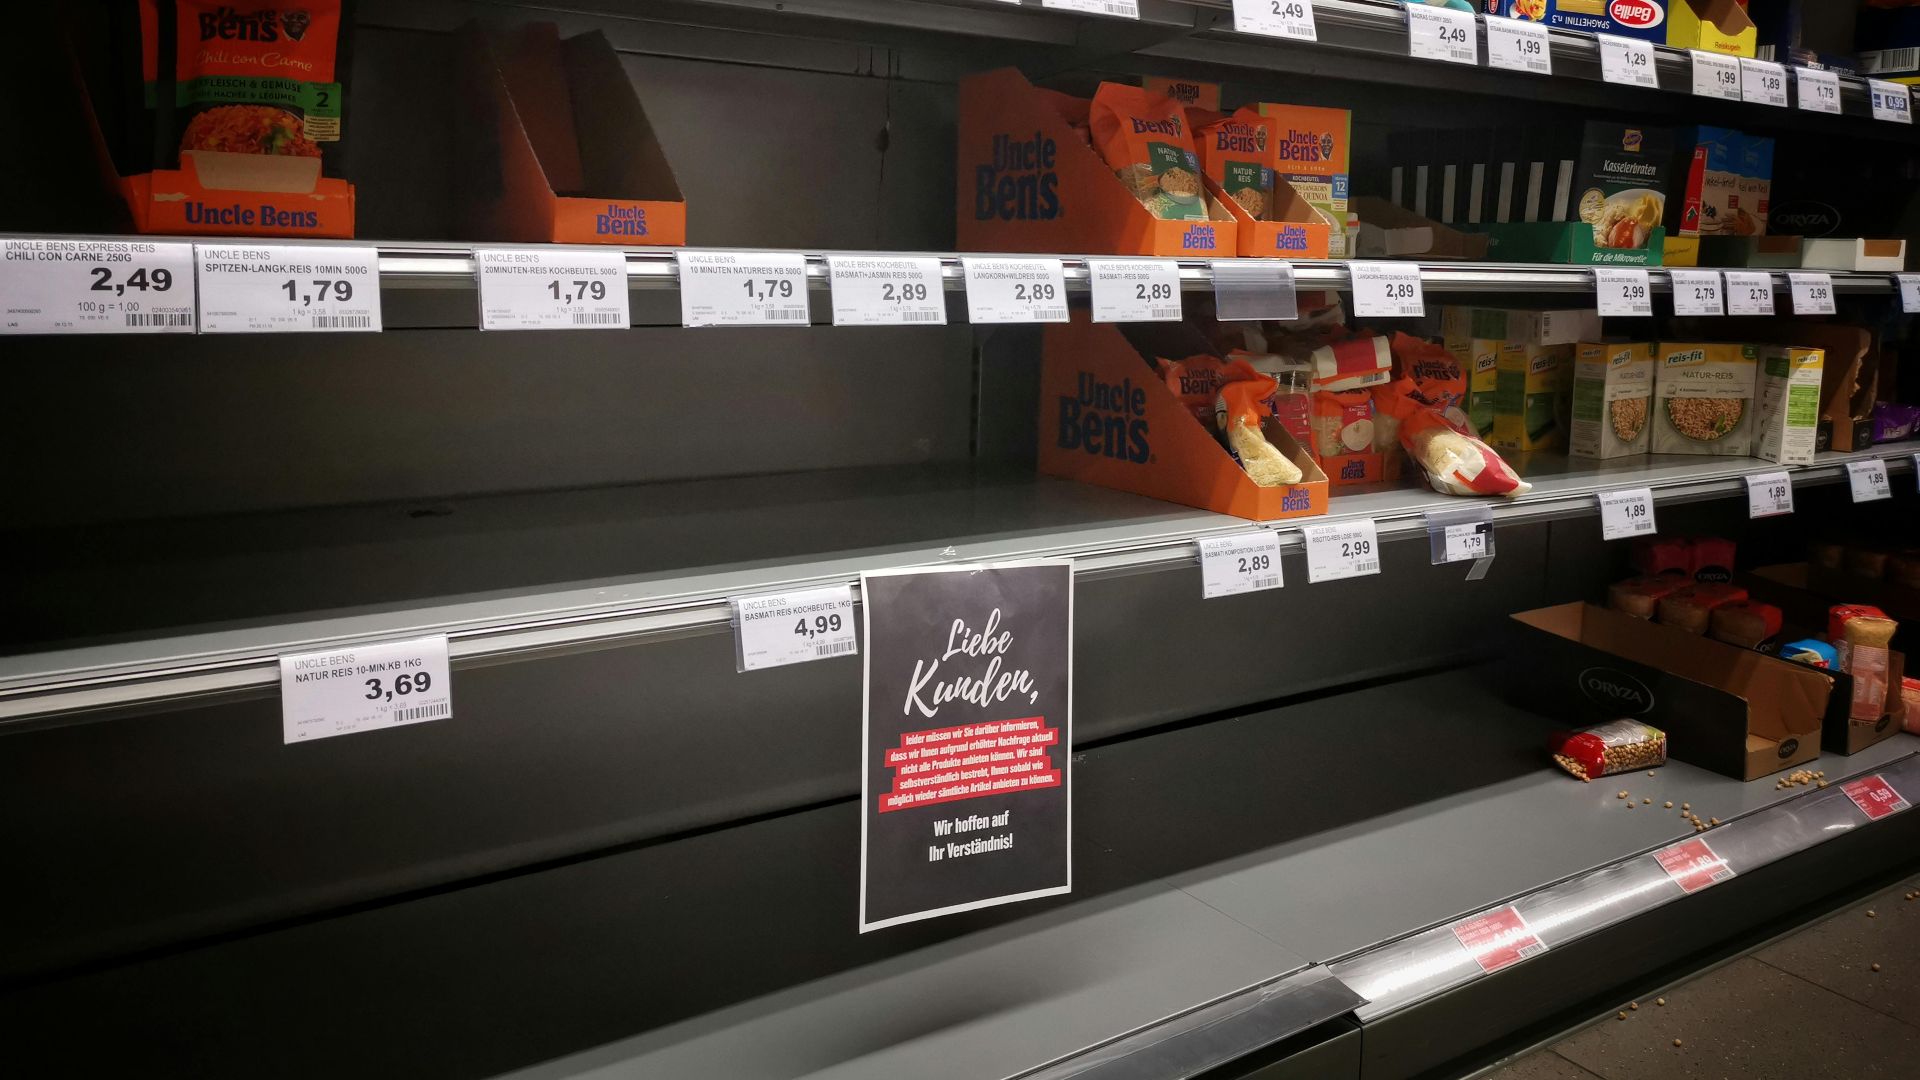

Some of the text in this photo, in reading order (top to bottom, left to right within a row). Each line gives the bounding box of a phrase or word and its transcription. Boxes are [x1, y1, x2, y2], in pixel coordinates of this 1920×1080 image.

[1271, 1, 1303, 19] 2,49
[1614, 3, 1651, 21] Barilla
[1565, 17, 1610, 29] SPAGHETTINI
[1439, 26, 1466, 44] 2,49
[1516, 39, 1540, 56] 1,99
[232, 52, 313, 72] con Carne
[1624, 51, 1646, 67] 1,29
[1716, 70, 1736, 85] 1,99
[1761, 76, 1780, 91] 1,89
[316, 92, 329, 108] 2
[1817, 85, 1834, 99] 1,79
[1223, 122, 1254, 137] Uncle
[1288, 129, 1318, 145] Uncle
[993, 131, 1057, 172] Uncle
[1233, 167, 1256, 176] NATUR-
[1603, 160, 1657, 176] Kasselerbraten
[1238, 175, 1252, 183] REIS
[1336, 181, 1346, 192] 12
[185, 202, 256, 225] Uncle
[608, 204, 645, 220] Uncle
[1190, 224, 1215, 237] Uncle
[1284, 225, 1307, 237] Uncle
[6, 242, 155, 253] UNCLE BENS EXPRESS REIS
[204, 250, 270, 260] UNCLE BENS
[6, 251, 132, 262] CHILI CON CARNE 250G
[484, 254, 540, 263] UNCLE BEN'S
[1592, 252, 1602, 261] Für
[1602, 253, 1613, 262] die
[205, 264, 368, 275] SPITZEN-LANGK.REIS 10MIN 500G
[485, 266, 617, 275] 20MINUTEN-REIS KOCHBEUTEL 500G
[700, 266, 802, 275] MINUTEN NATURREIS 500G
[857, 261, 876, 269] BEN'S
[90, 267, 173, 297] 2,49
[835, 271, 891, 279] BASMATI+JASMIN
[282, 279, 353, 306] 1,79
[547, 280, 606, 305] 1,79
[743, 279, 793, 302] 1,79
[882, 283, 927, 304] 2,89
[1014, 283, 1055, 303] 2,89
[1136, 283, 1171, 303] 2,89
[1385, 283, 1414, 301] 2,89
[1623, 285, 1644, 301] 2,99
[1695, 287, 1715, 301] 2,79
[1750, 288, 1768, 302] 2,79
[1810, 288, 1827, 301] 2,99
[78, 302, 139, 314] 100 g 1,00
[1667, 350, 1703, 365] reis-fit
[1682, 370, 1734, 380] NATUR-REIS
[1079, 372, 1146, 416] Uncle
[1868, 472, 1884, 485] 1,89
[1288, 487, 1310, 500] Uncle
[1768, 486, 1786, 500] 1,89
[1625, 504, 1646, 520] 1,89
[1342, 540, 1370, 559] 2,99
[1463, 537, 1481, 550] 1,79
[1238, 555, 1270, 575] 2,89
[743, 598, 787, 611] UNCLE BENS
[745, 600, 851, 621] BASMATI REIS KOCHBEUTEL 1KG
[794, 614, 842, 639] 4,99
[942, 607, 1014, 662] Liebe
[295, 654, 355, 670] UNCLE BENS
[295, 658, 422, 683] NATUR REIS 10-MIN.KB 1KG
[365, 671, 431, 702] 3,69
[903, 655, 1039, 718] Kunden,
[1588, 677, 1644, 703] ORYZA
[906, 720, 1040, 745] leider müssen wir Sie darüber informieren,
[890, 731, 1053, 762] dass wir Ihnen aufgrund erhöhter Nachfrage aktuell
[901, 746, 1043, 775] nicht alle Produkte anbieten können. Wir sind
[900, 760, 1043, 789] selbstverständlich bestrebt, Ihnen sobald wie
[888, 774, 1054, 807] möglich wieder sämtliche Artikel anbieten zu können.
[933, 810, 1010, 837] Wir hoffen auf
[929, 833, 1013, 862] Ihr Verständnis!
